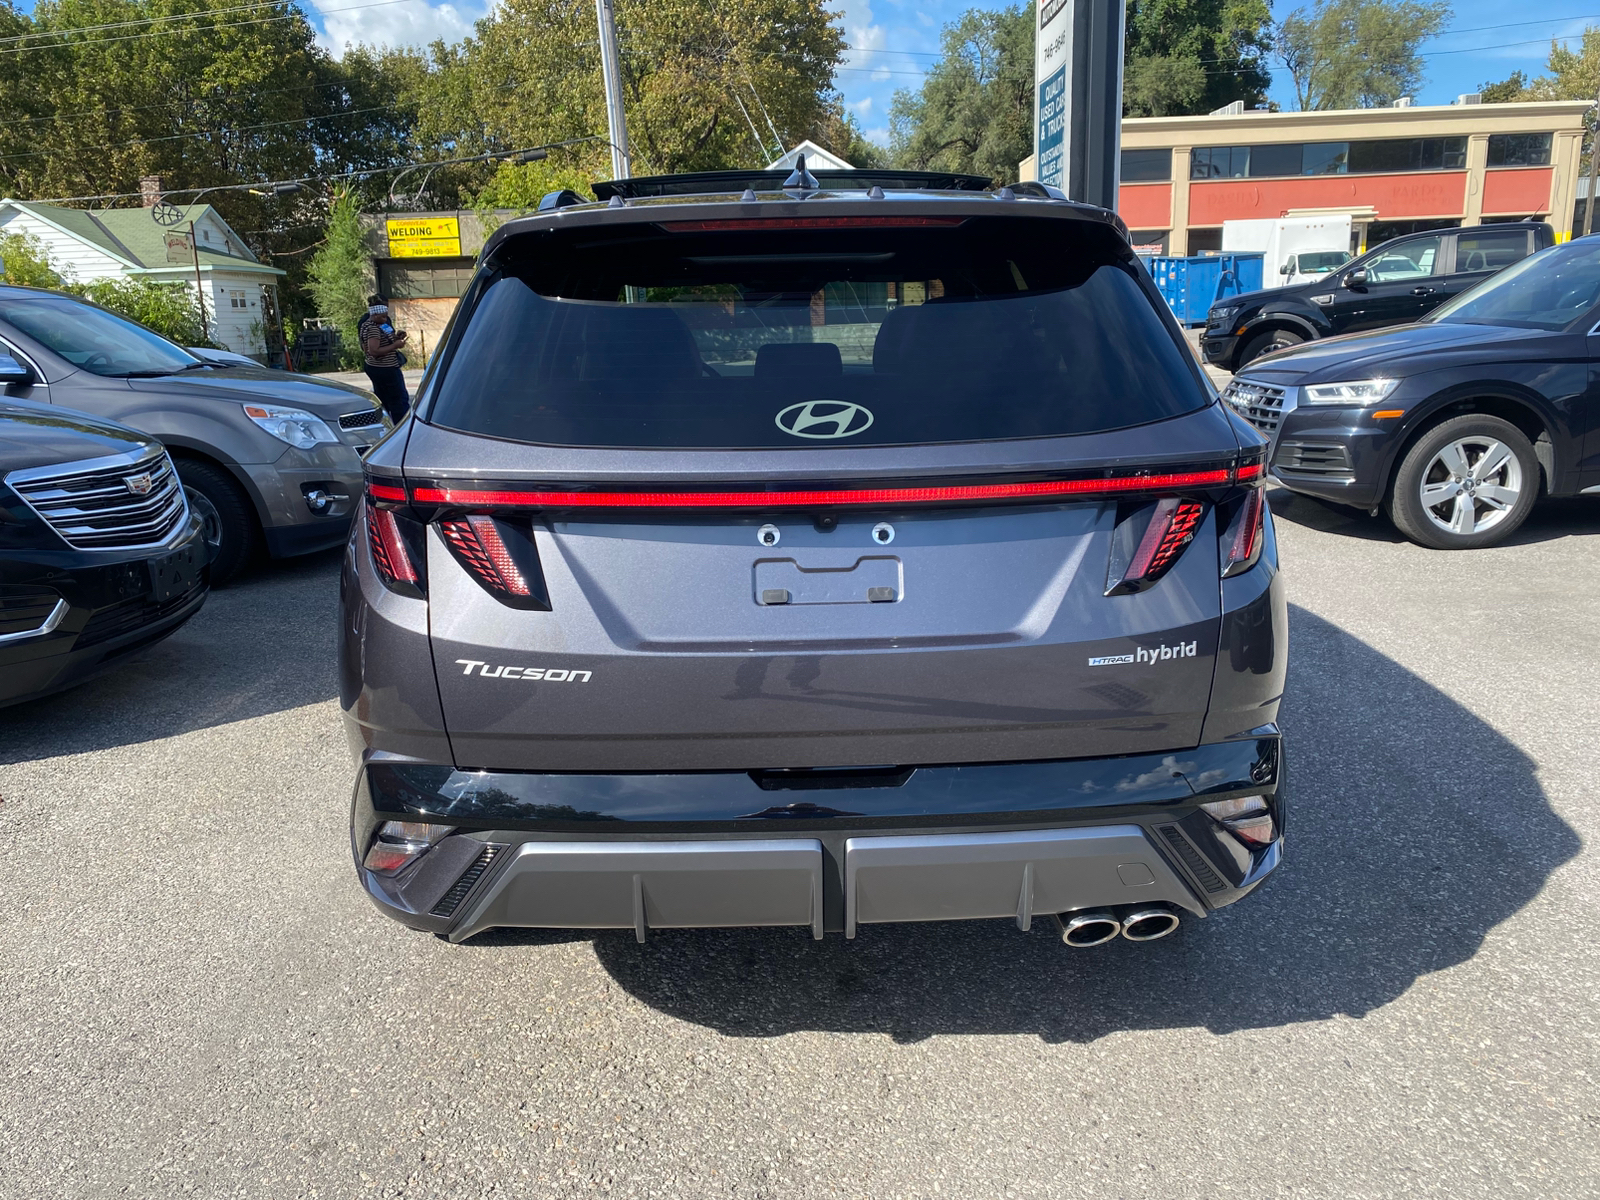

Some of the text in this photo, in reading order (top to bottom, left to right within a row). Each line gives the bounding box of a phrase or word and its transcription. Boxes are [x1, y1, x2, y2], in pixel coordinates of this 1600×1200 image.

[1045, 74, 1064, 101] QUALITY
[1041, 101, 1054, 122] USED
[1041, 125, 1045, 140] &
[390, 227, 432, 236] WELDING
[1092, 640, 1197, 666] HTRAC hybrid
